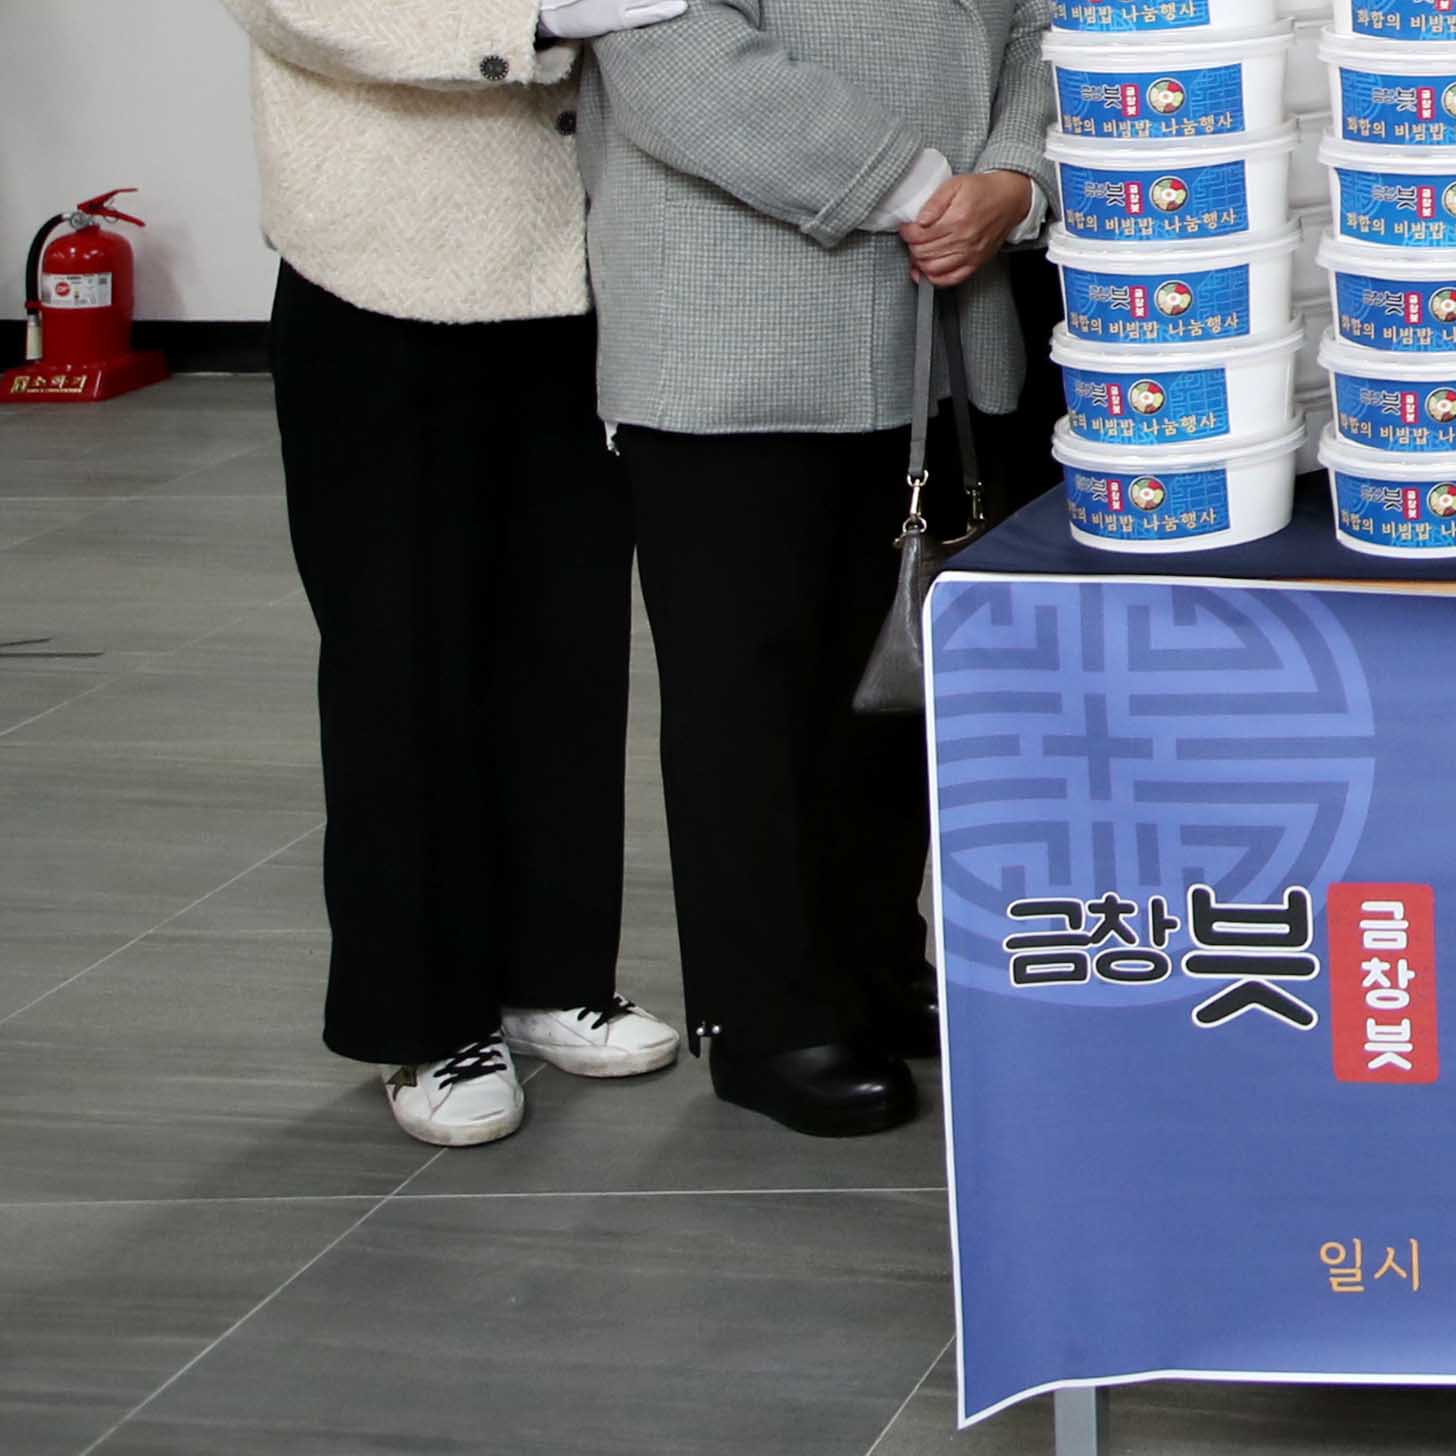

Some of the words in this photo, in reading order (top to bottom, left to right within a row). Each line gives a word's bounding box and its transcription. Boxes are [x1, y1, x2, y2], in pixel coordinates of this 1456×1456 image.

[1122, 0, 1197, 22] 나눔행사
[1357, 9, 1400, 29] 화합의
[1161, 112, 1233, 135] 나눔행사
[1347, 117, 1386, 137] 화합의
[1395, 122, 1447, 140] 비빔밥
[1106, 216, 1155, 236] 비빔밥
[1164, 209, 1237, 232] 나눔행사
[1346, 213, 1385, 234] 화합의
[1394, 220, 1446, 238] 비빔밥
[1109, 319, 1160, 338] 비빔밥
[1168, 313, 1240, 336] 나눔행사
[1384, 325, 1434, 344] 비빔밥
[1092, 419, 1135, 436] 비빔밥
[1144, 413, 1217, 436] 나눔행사
[1380, 425, 1430, 444] 비빔밥
[1092, 514, 1135, 532] 비빔밥
[1144, 508, 1217, 532] 나눔행사
[1382, 522, 1432, 540] 비빔밥
[1319, 1238, 1421, 1292] 일시
